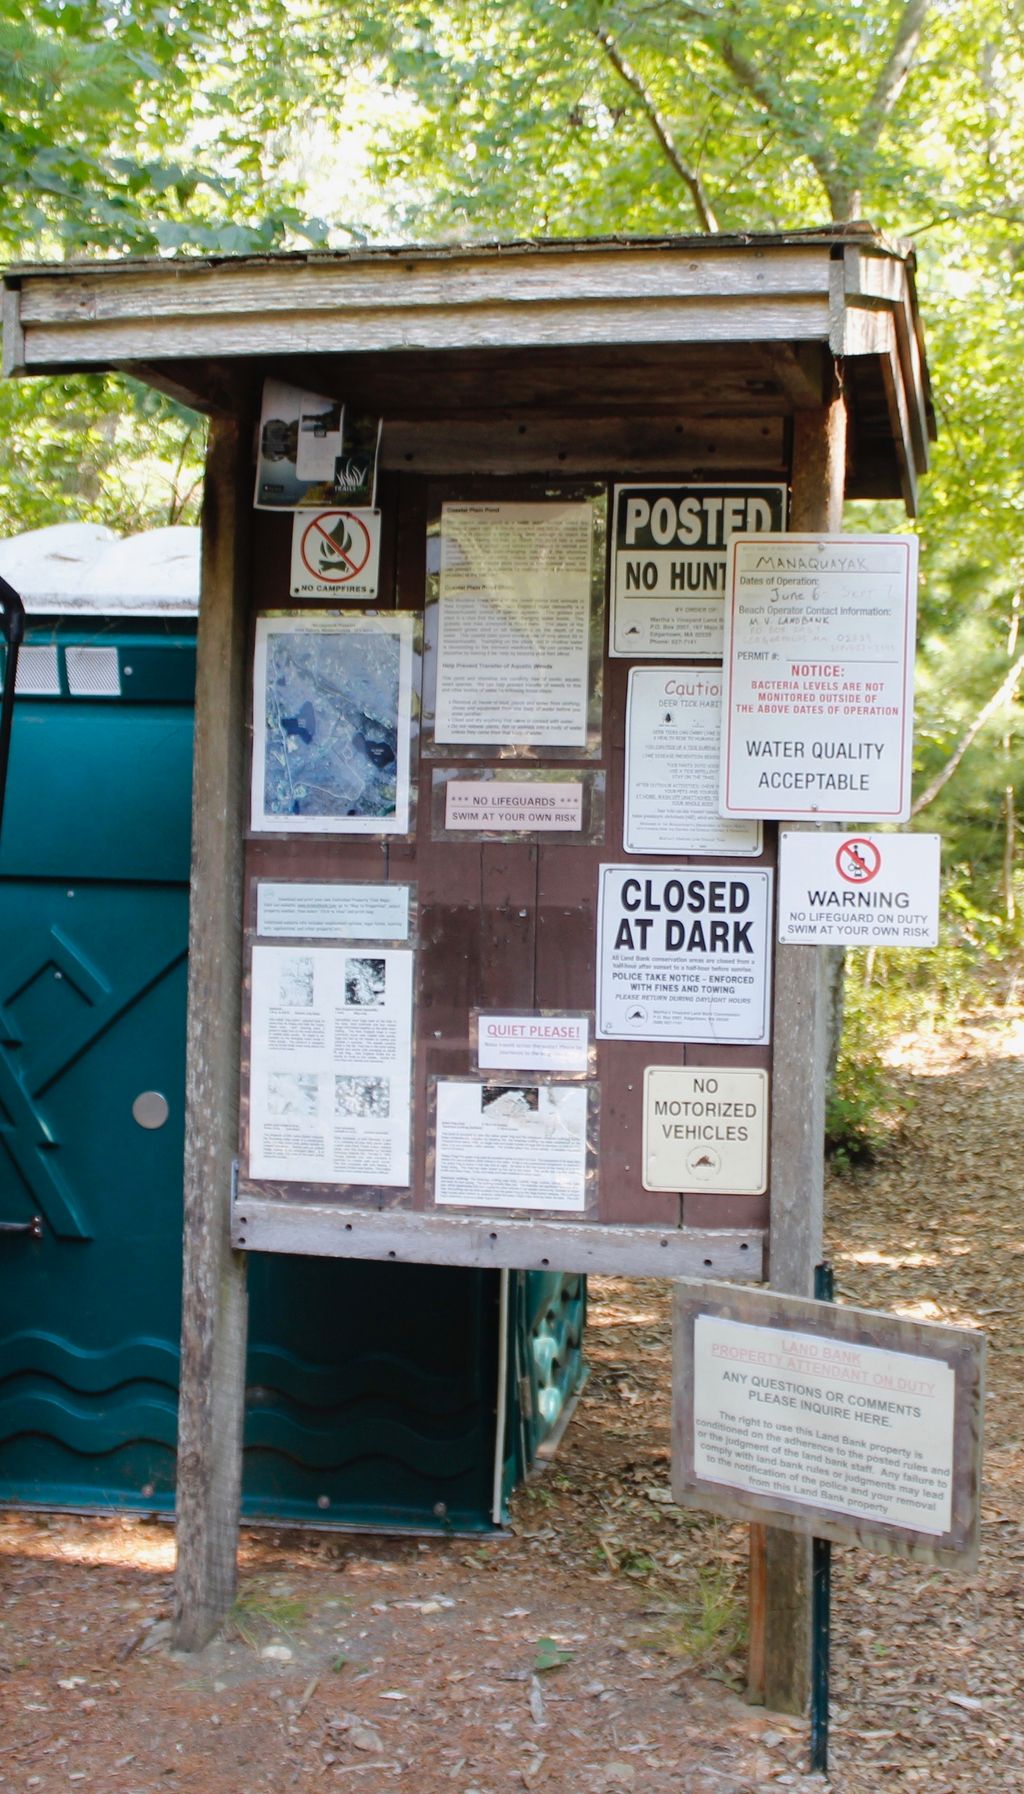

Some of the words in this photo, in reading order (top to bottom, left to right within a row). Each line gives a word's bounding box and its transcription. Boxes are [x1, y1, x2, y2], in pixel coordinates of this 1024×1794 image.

[625, 497, 772, 545] POSTED
[626, 562, 658, 591] NO
[740, 577, 763, 586] Dates
[766, 577, 775, 586] of
[776, 577, 820, 587] Operation:
[316, 585, 367, 593] CAMPFIRES
[770, 588, 803, 602] June
[739, 605, 765, 614] Beach
[767, 605, 802, 616] Operator
[805, 606, 838, 616] Contact
[840, 606, 892, 617] Information:
[737, 652, 769, 661] PERMIT
[791, 665, 845, 678] NOTICE:
[664, 680, 722, 696] Cautio
[751, 681, 799, 690] BACTERIA
[803, 681, 838, 691] LEVELS
[842, 682, 862, 691] ARE
[865, 683, 884, 692] NOT
[758, 693, 815, 702] MONITORED
[819, 694, 861, 703] OUTSIDE
[864, 695, 877, 703] OF
[736, 705, 754, 713] THE
[757, 705, 790, 714] ABOVE
[793, 705, 824, 715] DATES
[827, 706, 840, 715] OF
[843, 706, 899, 716] OPERATION
[746, 740, 805, 758] WATER
[811, 741, 885, 760] QUALITY
[758, 772, 870, 791] ACCEPTABLE
[473, 797, 488, 806] NO
[491, 797, 556, 807] LIFEGUARDS
[452, 812, 479, 821] SWIM
[482, 812, 494, 821] AT
[499, 812, 525, 822] YOUR
[528, 813, 551, 822] OWN
[554, 814, 577, 823] RISK
[620, 878, 750, 914] CLOSED
[807, 890, 910, 908] WARNING
[790, 912, 806, 922] NO
[809, 912, 874, 923] LIFEGUARD
[877, 914, 894, 924] ON
[897, 914, 928, 924] DUTY
[614, 918, 654, 951] AT
[665, 919, 754, 954] DARK
[787, 924, 817, 934] SWIM
[820, 925, 834, 934] AT
[837, 926, 869, 935] YOUR
[872, 926, 900, 936] OWN
[902, 927, 930, 937] RISK
[612, 972, 642, 981] POLICE
[645, 973, 667, 982] TAKE
[669, 974, 700, 983] NOTICE
[709, 975, 754, 984] ENFORCED
[630, 983, 652, 992] WITH
[654, 984, 679, 993] FINES
[681, 985, 699, 993] AND
[702, 985, 736, 995] TOWING
[641, 994, 668, 1002] RETURN
[695, 996, 728, 1004] DAYLIGHT
[487, 1024, 527, 1037] QUIET
[530, 1025, 580, 1038] PLEASE!
[693, 1078, 719, 1094] NO
[654, 1101, 757, 1118] MOTORIZED
[662, 1124, 748, 1141] VEHICLES
[781, 1339, 818, 1357] LAND
[823, 1348, 861, 1364] BANK
[712, 1343, 784, 1365] PROPERTY
[787, 1357, 870, 1380] ATTENDANT
[872, 1374, 894, 1388] ON
[897, 1377, 936, 1395] DUTY
[722, 1371, 748, 1384] ANY
[751, 1375, 822, 1399] QUESTIONS
[825, 1390, 844, 1404] OR
[847, 1394, 921, 1418] COMMENTS
[748, 1390, 798, 1408] PLEASE
[800, 1400, 851, 1420] INQUIRE
[854, 1411, 893, 1428] HERE.
[719, 1410, 736, 1421] The
[738, 1414, 760, 1427] right
[763, 1420, 773, 1429] to
[775, 1423, 793, 1433] use
[795, 1425, 813, 1437] this
[816, 1430, 840, 1443] Land
[842, 1435, 868, 1448] Bank
[869, 1443, 912, 1459] property
[914, 1450, 924, 1460] is
[695, 1418, 749, 1437] conditioned
[751, 1431, 764, 1440] on
[766, 1432, 782, 1443] the
[784, 1437, 834, 1454] adherence
[836, 1447, 846, 1457] to
[848, 1449, 865, 1460] the
[866, 1454, 901, 1468] posted
[903, 1461, 929, 1473] rules
[930, 1466, 951, 1477] and
[697, 1430, 707, 1438] or
[709, 1431, 724, 1441] the
[725, 1436, 769, 1453] judgment
[771, 1446, 782, 1455] of
[784, 1447, 800, 1458] the
[801, 1451, 823, 1464] land
[825, 1456, 848, 1469] bank
[880, 1468, 900, 1481] Any
[902, 1472, 935, 1487] failure
[936, 1479, 948, 1489] to
[700, 1441, 733, 1458] comply
[735, 1450, 754, 1461] with
[756, 1454, 778, 1466] land
[779, 1458, 804, 1471] bank
[806, 1463, 830, 1476] rules
[832, 1471, 844, 1479] or
[845, 1471, 897, 1491] judgments
[899, 1484, 920, 1498] may
[922, 1488, 945, 1501] lead
[706, 1454, 716, 1463] to
[718, 1457, 732, 1468] the
[734, 1461, 787, 1480] notification
[789, 1473, 800, 1482] of
[801, 1475, 817, 1486] the
[819, 1479, 849, 1492] police
[850, 1486, 869, 1497] and
[871, 1491, 894, 1503] your
[896, 1496, 937, 1512] removal
[748, 1475, 771, 1489] from
[773, 1481, 791, 1492] this
[793, 1485, 818, 1498] Land
[820, 1490, 845, 1503] Bank
[847, 1497, 889, 1515] property
